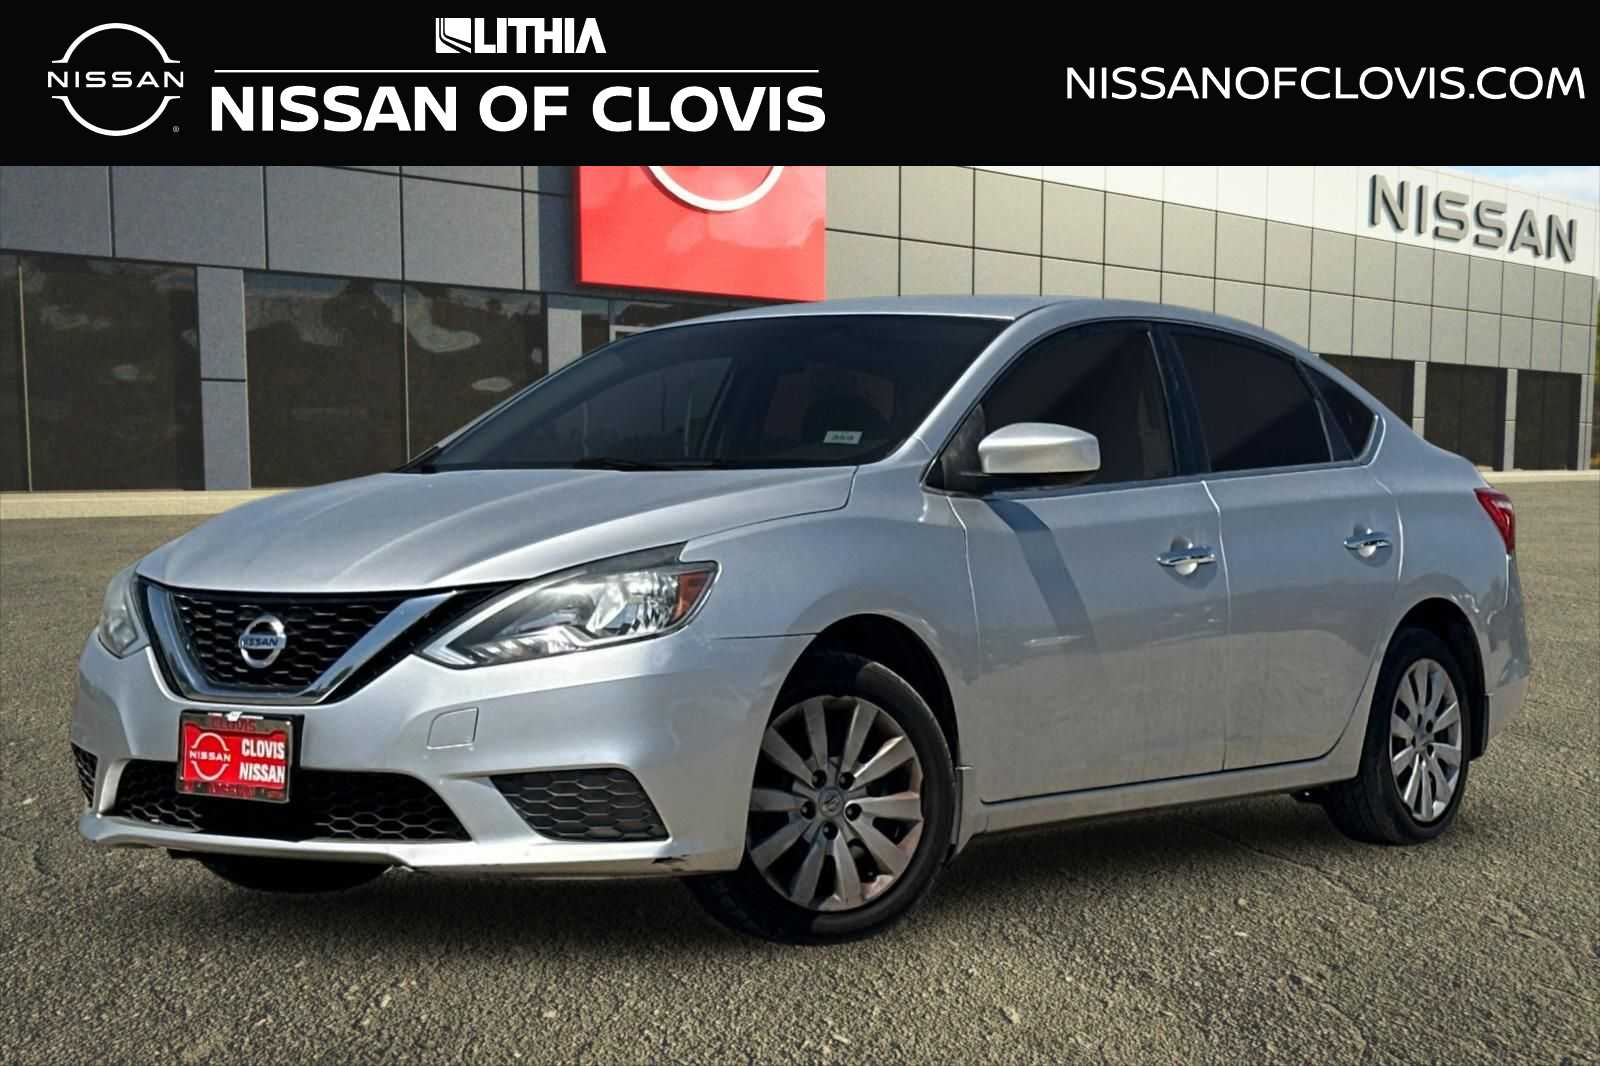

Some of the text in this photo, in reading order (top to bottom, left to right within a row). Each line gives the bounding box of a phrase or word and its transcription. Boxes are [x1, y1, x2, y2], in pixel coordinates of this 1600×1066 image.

[1369, 174, 1577, 262] NISSAN
[189, 750, 231, 762] NISSAN
[241, 738, 285, 759] CLOVIS
[239, 762, 286, 784] NISSAN
